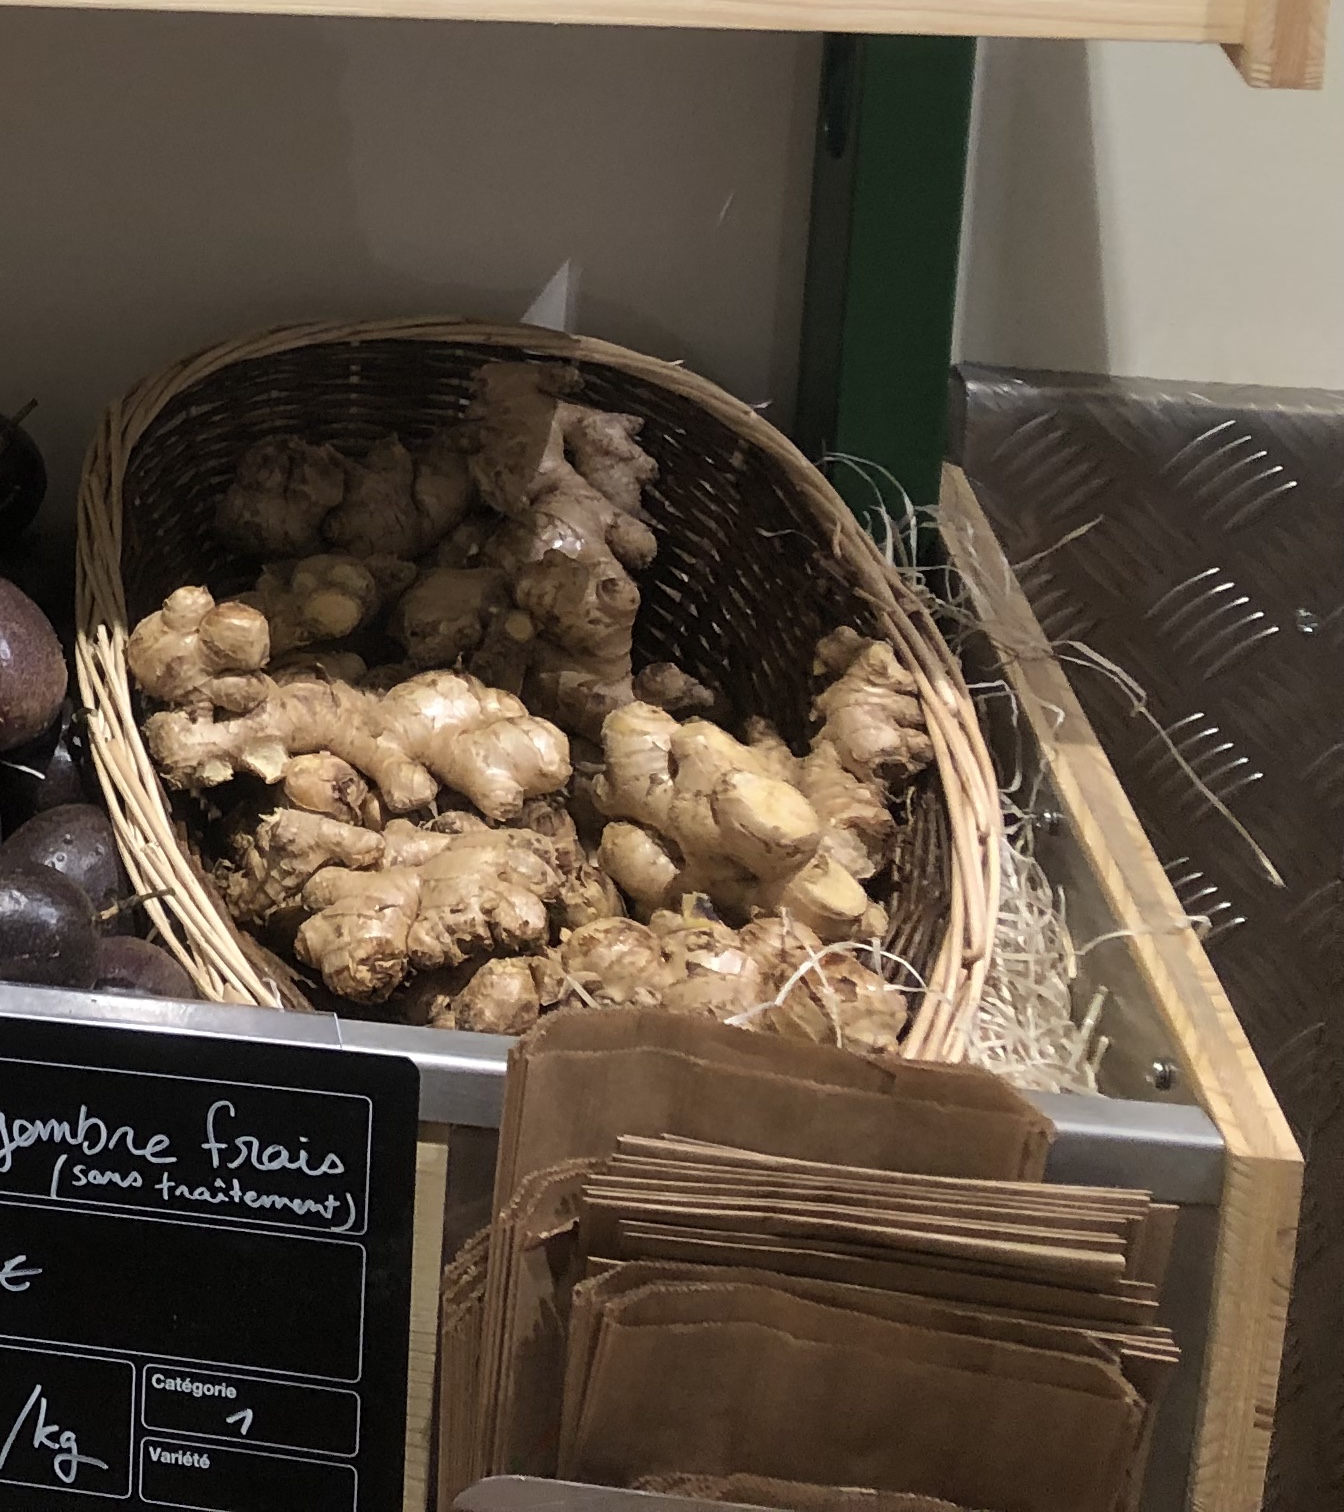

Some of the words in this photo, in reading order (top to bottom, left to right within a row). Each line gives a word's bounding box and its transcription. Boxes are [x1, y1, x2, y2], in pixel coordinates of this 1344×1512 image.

[200, 1099, 345, 1177] frais
[151, 1373, 238, 1399] Catégorie
[226, 1408, 254, 1435] 1
[148, 1446, 211, 1470] Variété
